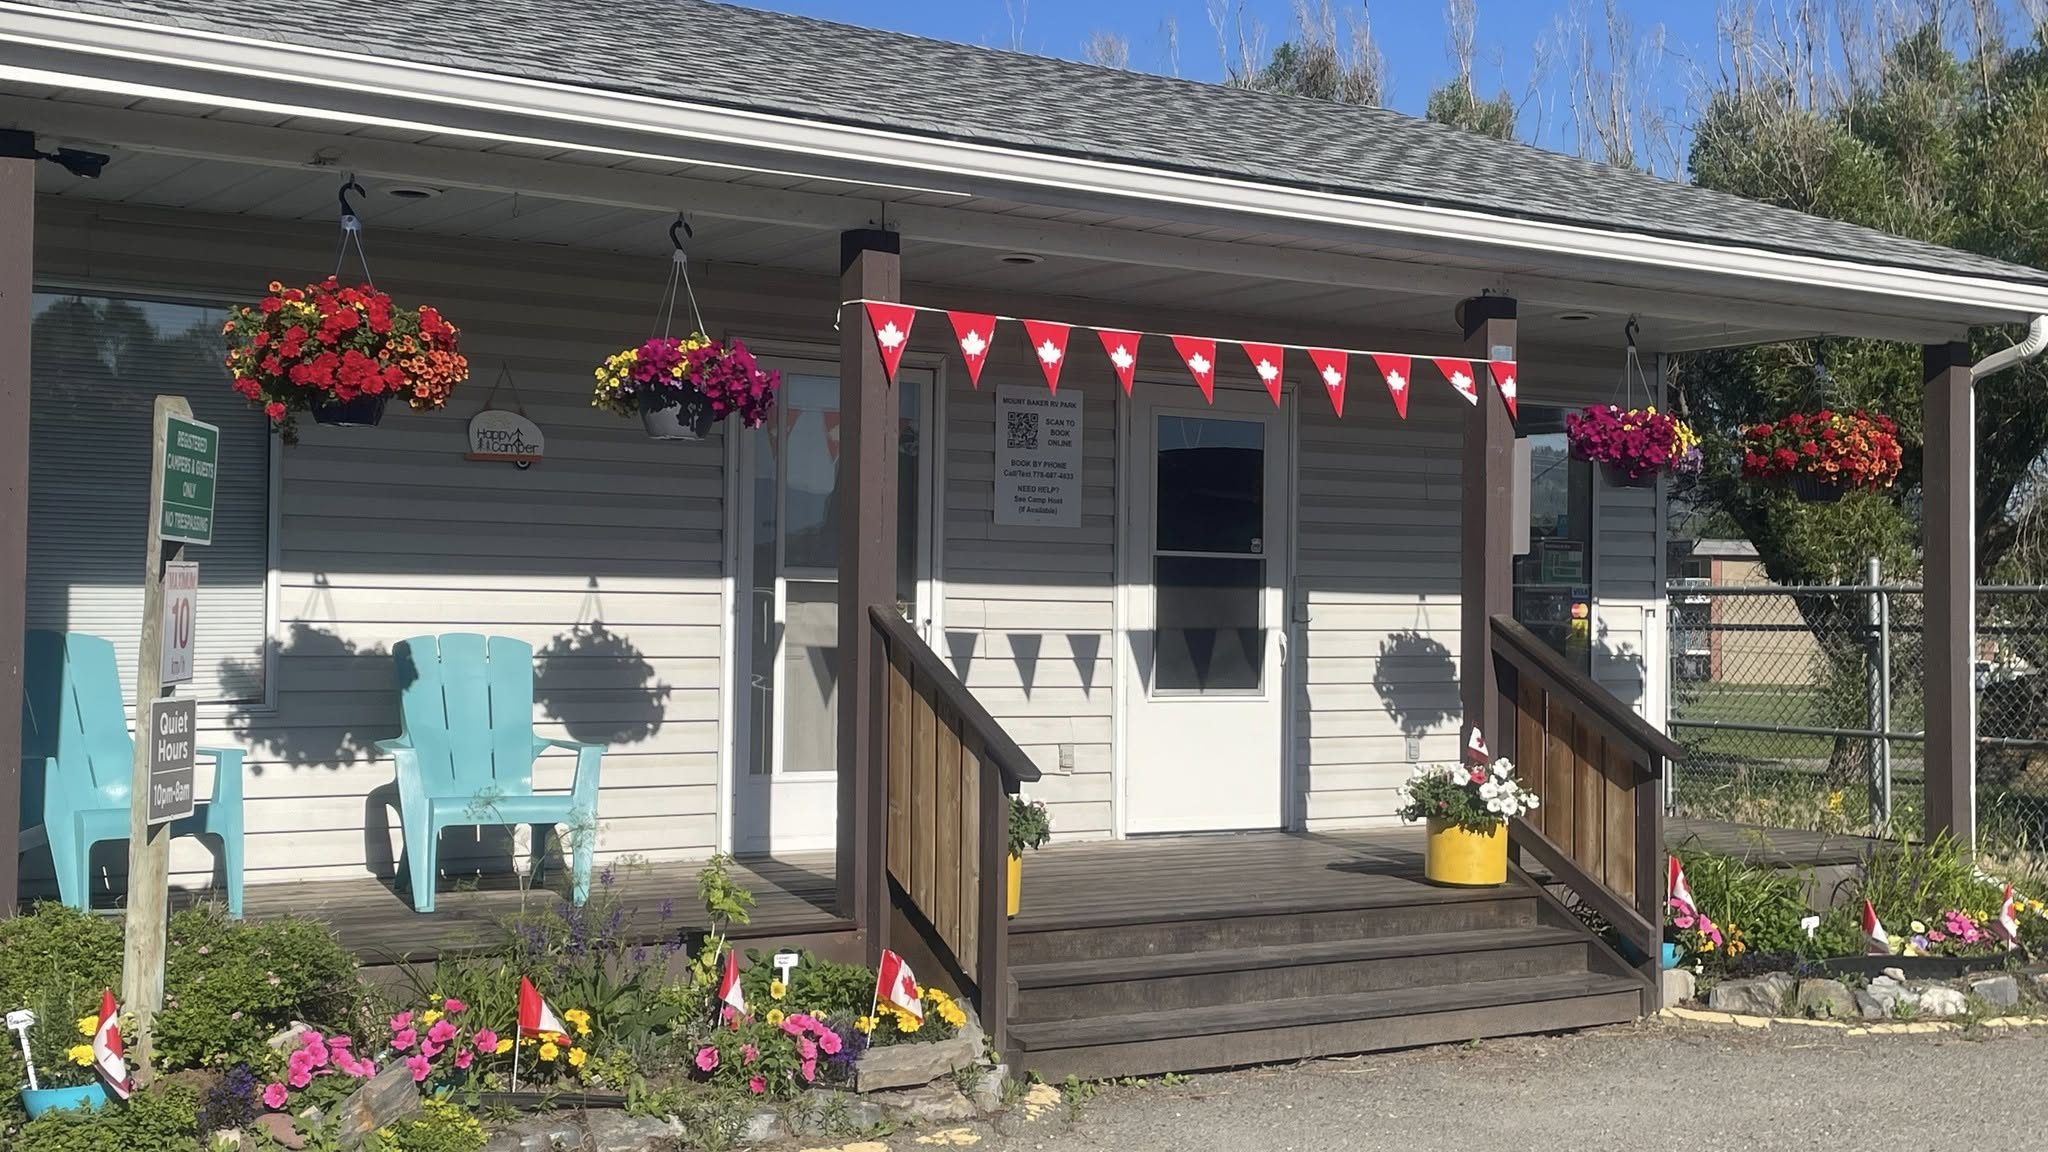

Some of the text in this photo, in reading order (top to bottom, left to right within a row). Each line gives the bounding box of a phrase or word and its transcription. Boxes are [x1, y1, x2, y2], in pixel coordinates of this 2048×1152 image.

[1027, 399, 1049, 407] BAKER
[1046, 418, 1065, 426] SCAN
[477, 428, 514, 441] Happy
[1050, 429, 1070, 437] BOOK
[177, 431, 207, 453] REGISTERED
[1048, 439, 1072, 447] ONLINE
[167, 453, 214, 479] CAMPERS & GUESTS
[1011, 459, 1031, 467] BOOK
[1043, 461, 1067, 469] PHONE
[183, 481, 197, 498] ONLY
[1017, 485, 1060, 494] NEED HELP?
[1014, 495, 1026, 503] See
[1028, 496, 1046, 504] Camp
[1026, 506, 1058, 515] Available)
[164, 511, 209, 532] NO TRESPASSING
[172, 598, 190, 649] 10
[160, 711, 189, 736] Quiet
[158, 740, 189, 762] Hours
[153, 780, 191, 809] 10pm-8am
